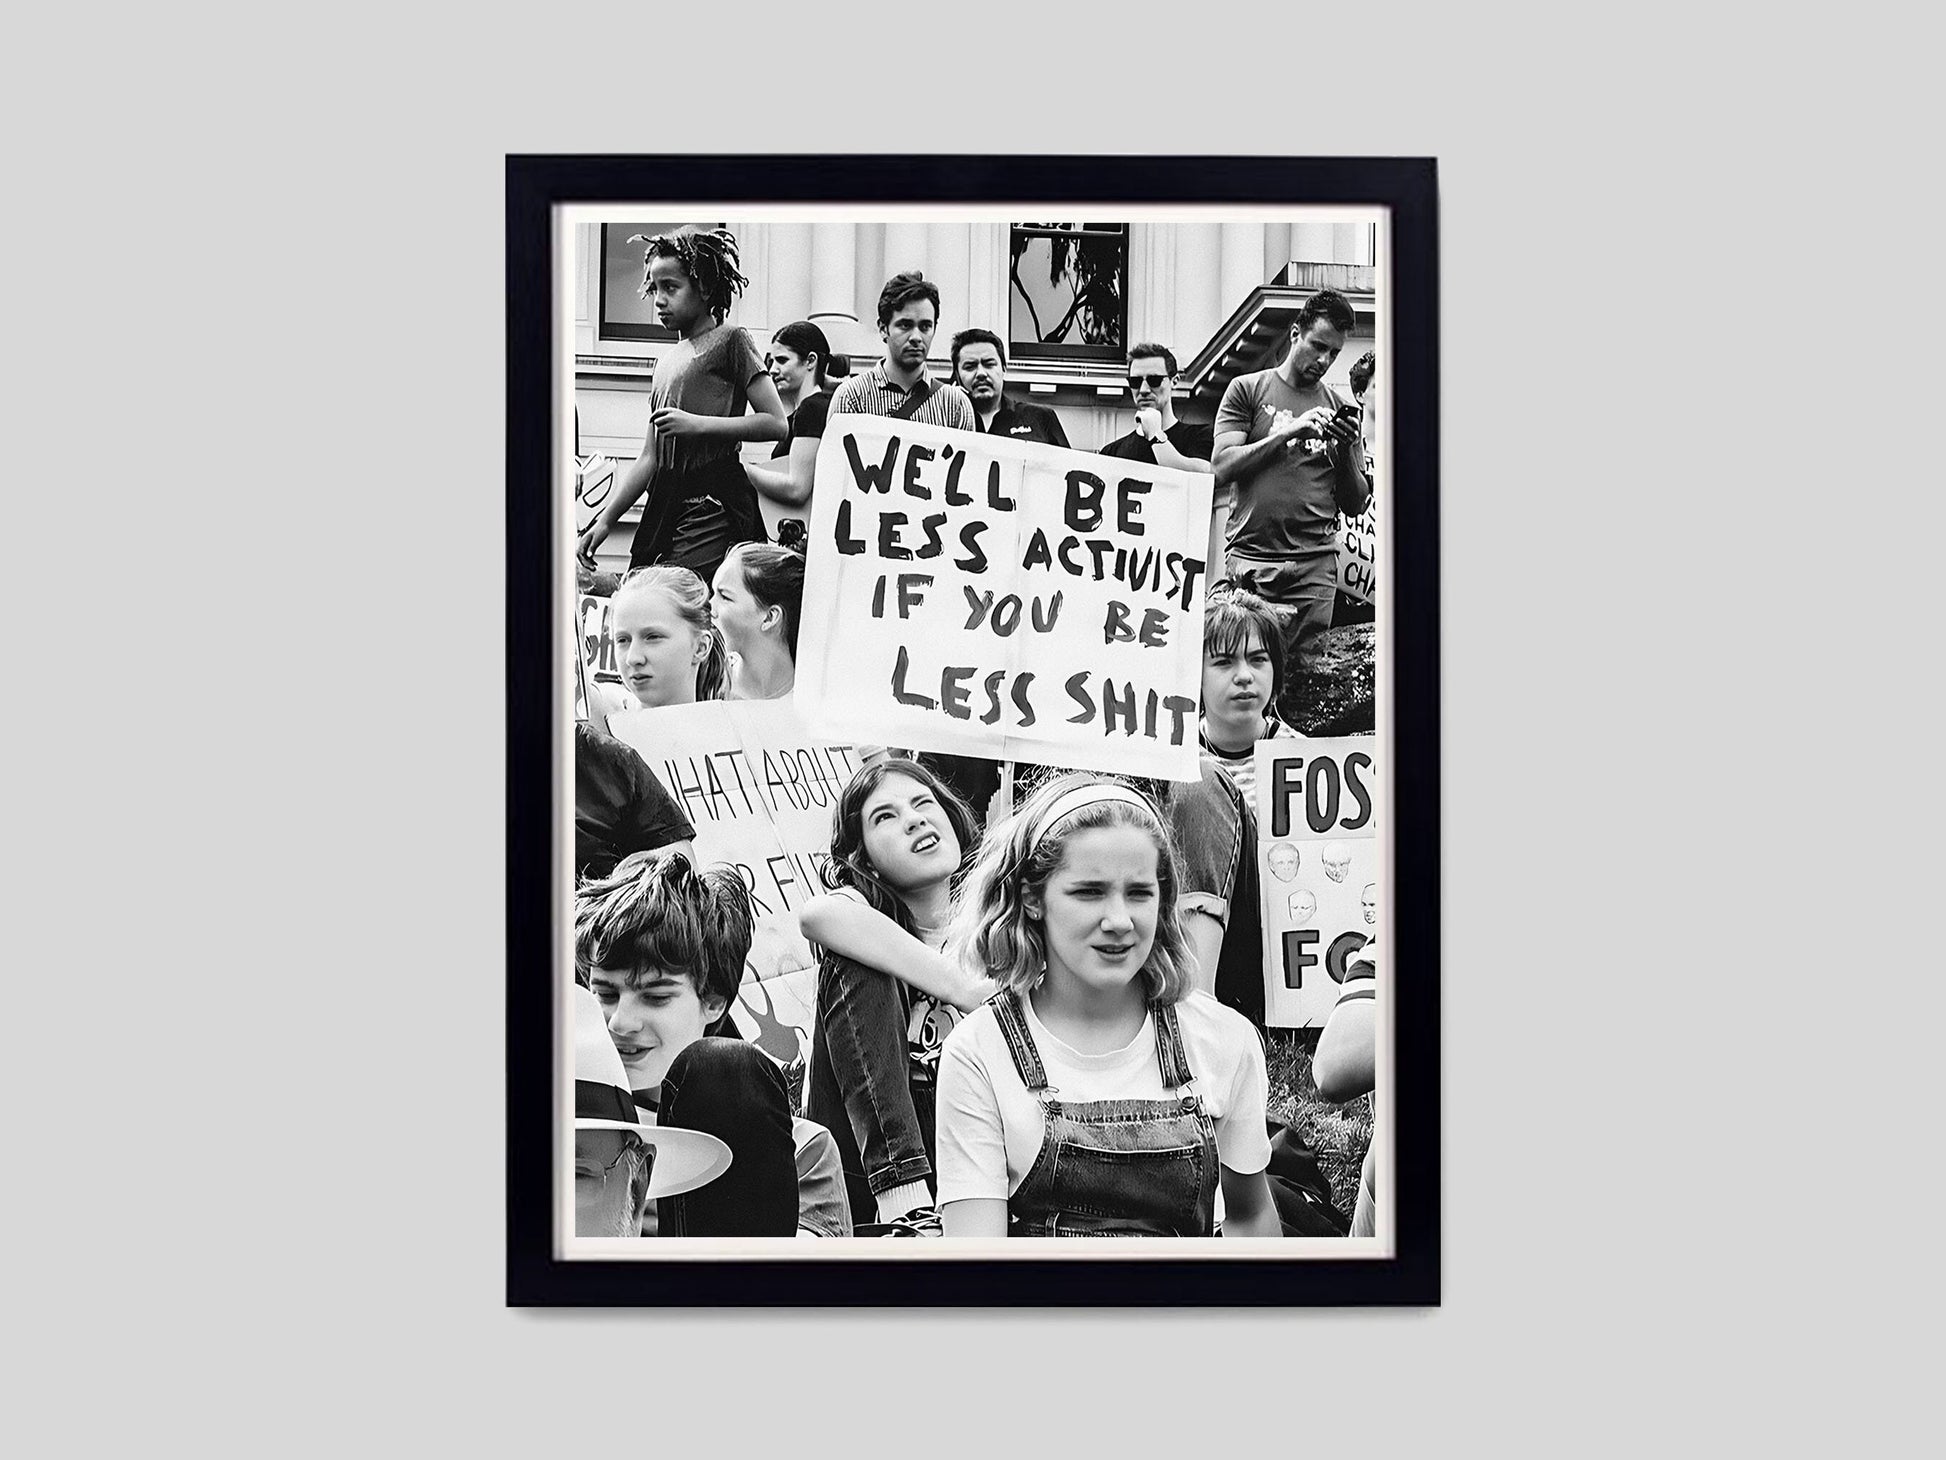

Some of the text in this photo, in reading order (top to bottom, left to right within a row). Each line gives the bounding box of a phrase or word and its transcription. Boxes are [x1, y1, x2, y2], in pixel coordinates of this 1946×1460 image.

[843, 433, 1153, 536] WE'LL BE
[835, 499, 1205, 612] LESS ACTIVIST
[872, 573, 1170, 648] IF YOU BE
[891, 646, 1196, 746] LESS SHIT
[763, 746, 853, 811] ABOUT
[1271, 751, 1376, 837] FOS
